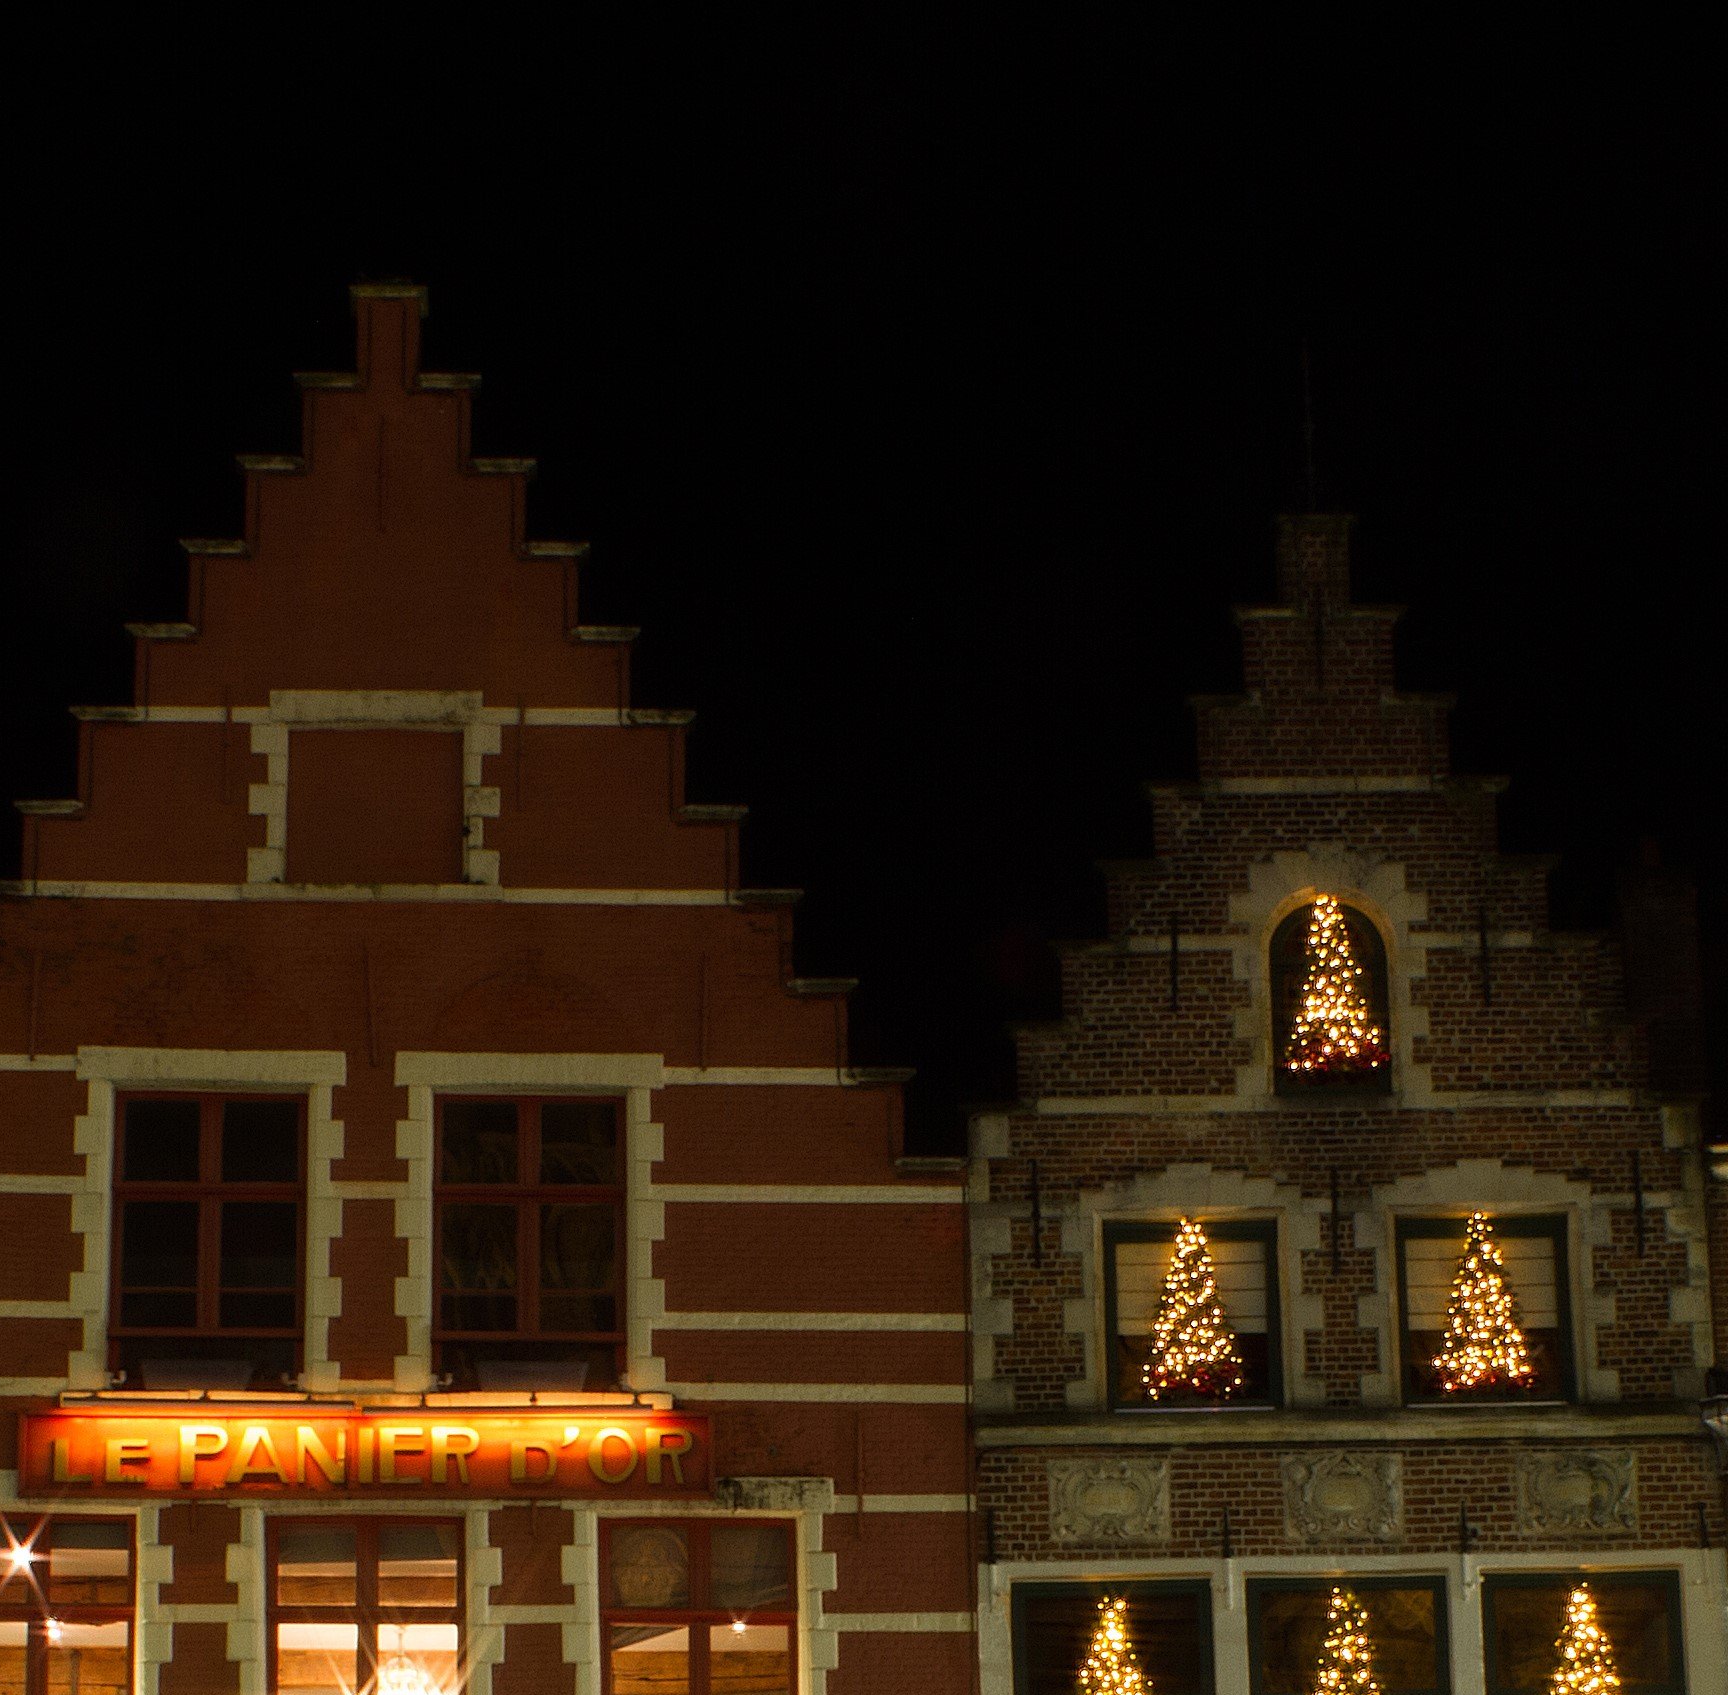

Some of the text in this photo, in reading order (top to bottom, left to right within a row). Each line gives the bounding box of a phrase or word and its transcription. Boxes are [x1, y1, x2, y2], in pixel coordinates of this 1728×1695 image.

[52, 1424, 695, 1486] LE PANIER D'OR
